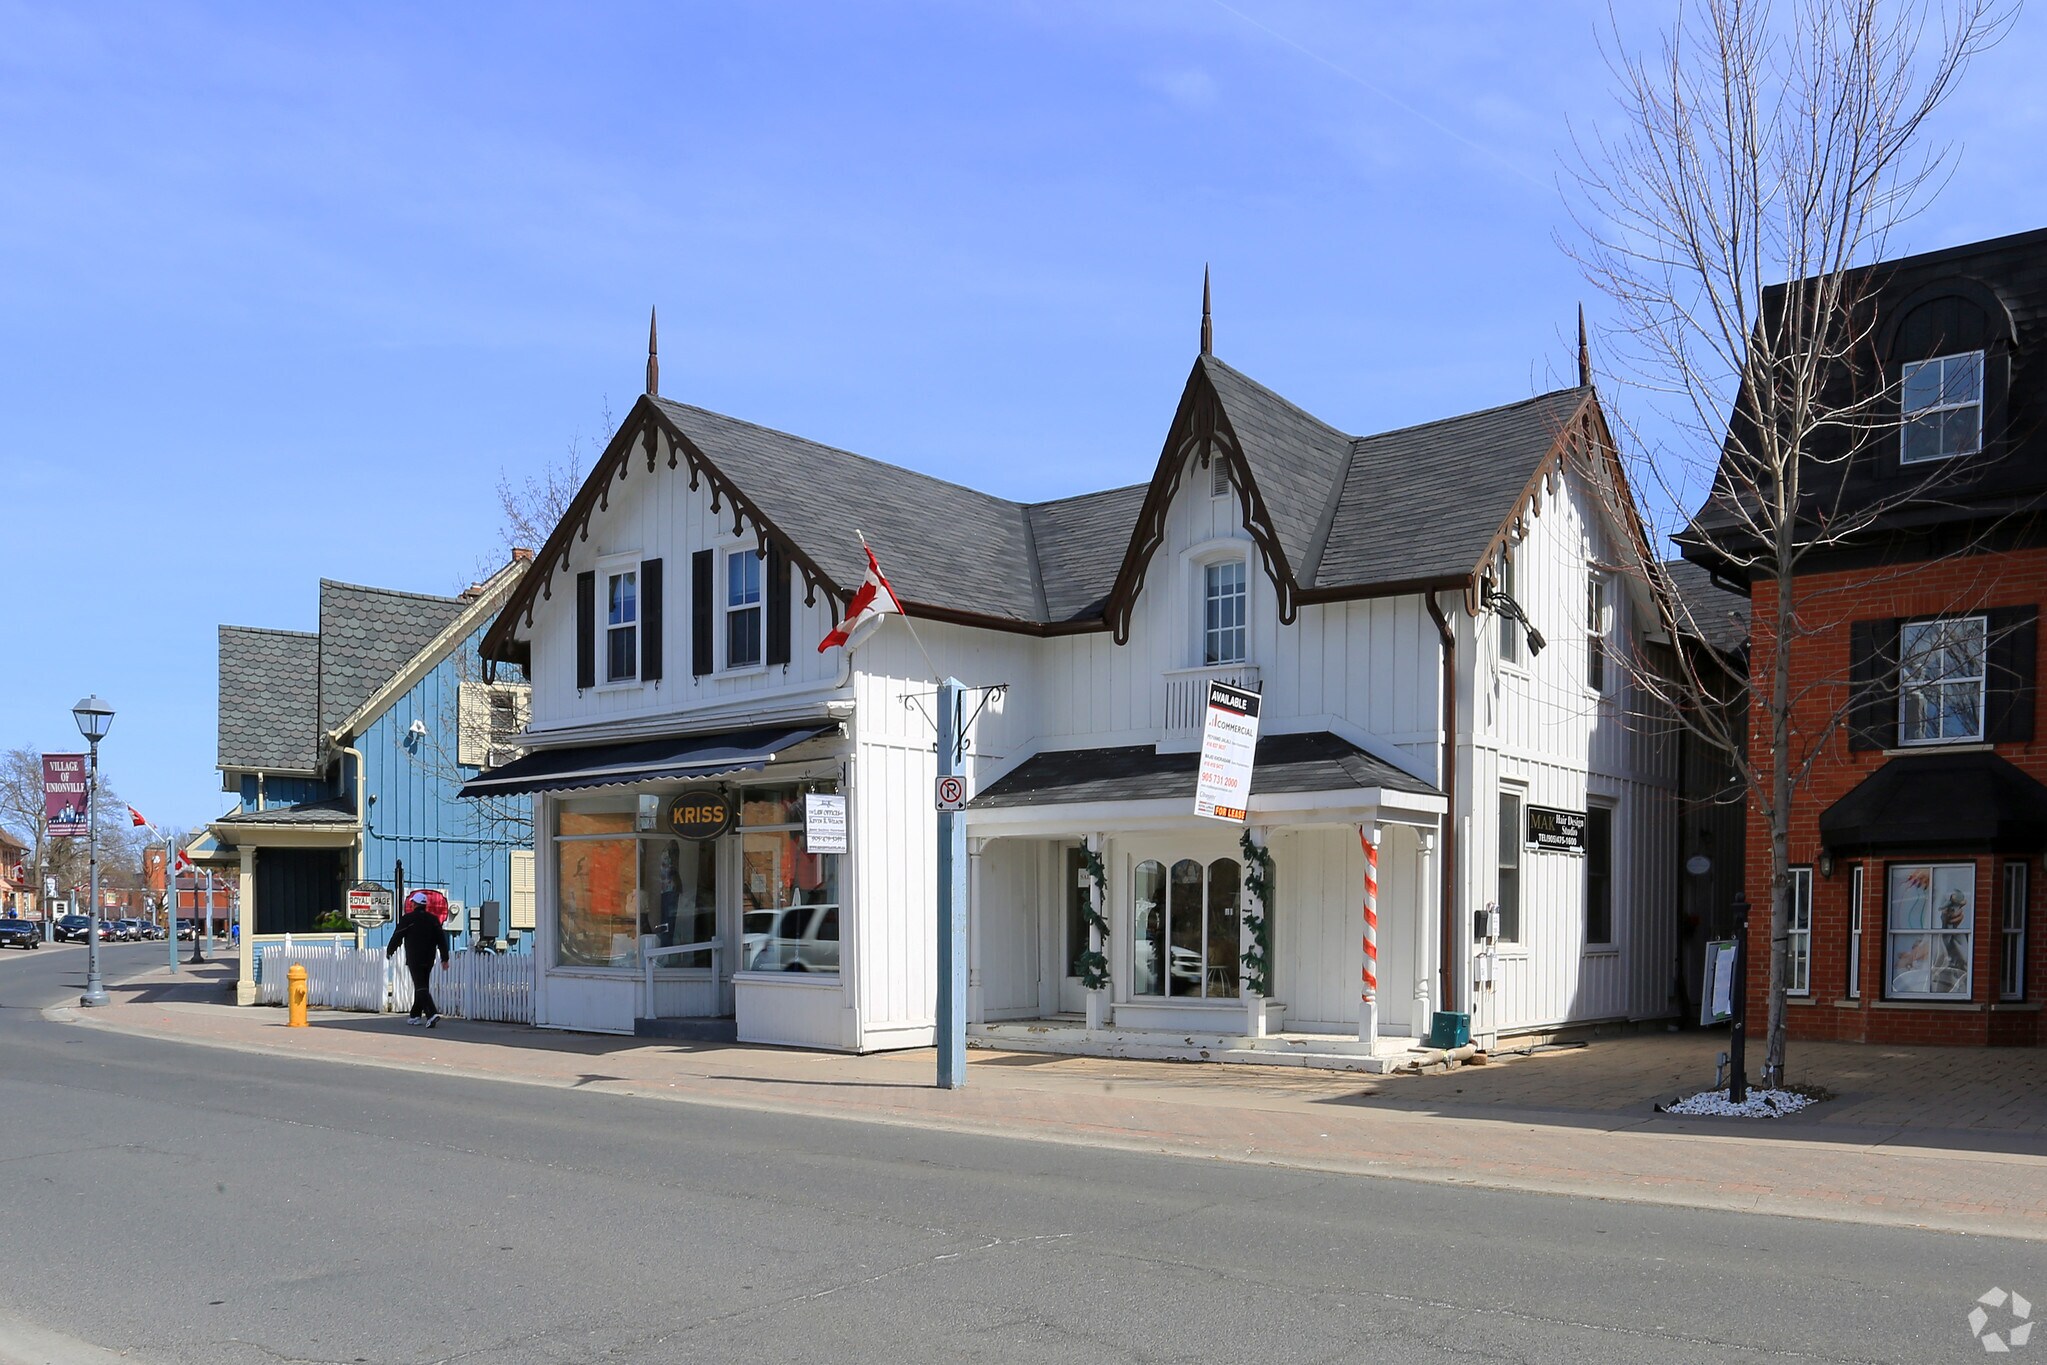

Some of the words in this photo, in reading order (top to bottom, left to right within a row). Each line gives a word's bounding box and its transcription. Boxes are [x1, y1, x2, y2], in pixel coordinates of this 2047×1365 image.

[1211, 690, 1248, 710] AVAILABLE
[1217, 720, 1254, 737] COMMERCIAL
[50, 761, 79, 772] VILLAGE
[60, 773, 70, 782] OF
[1202, 772, 1213, 783] 905
[1213, 774, 1224, 785] 731
[1224, 777, 1238, 788] 2000
[46, 782, 85, 793] UNIONVILLE
[673, 805, 724, 824] KRISS
[1215, 806, 1227, 817] FOR
[1227, 808, 1246, 820] LEASE
[1530, 813, 1555, 831] MAK
[1555, 813, 1568, 825] Hair
[1567, 815, 1584, 829] Design
[1561, 825, 1578, 837] Studio
